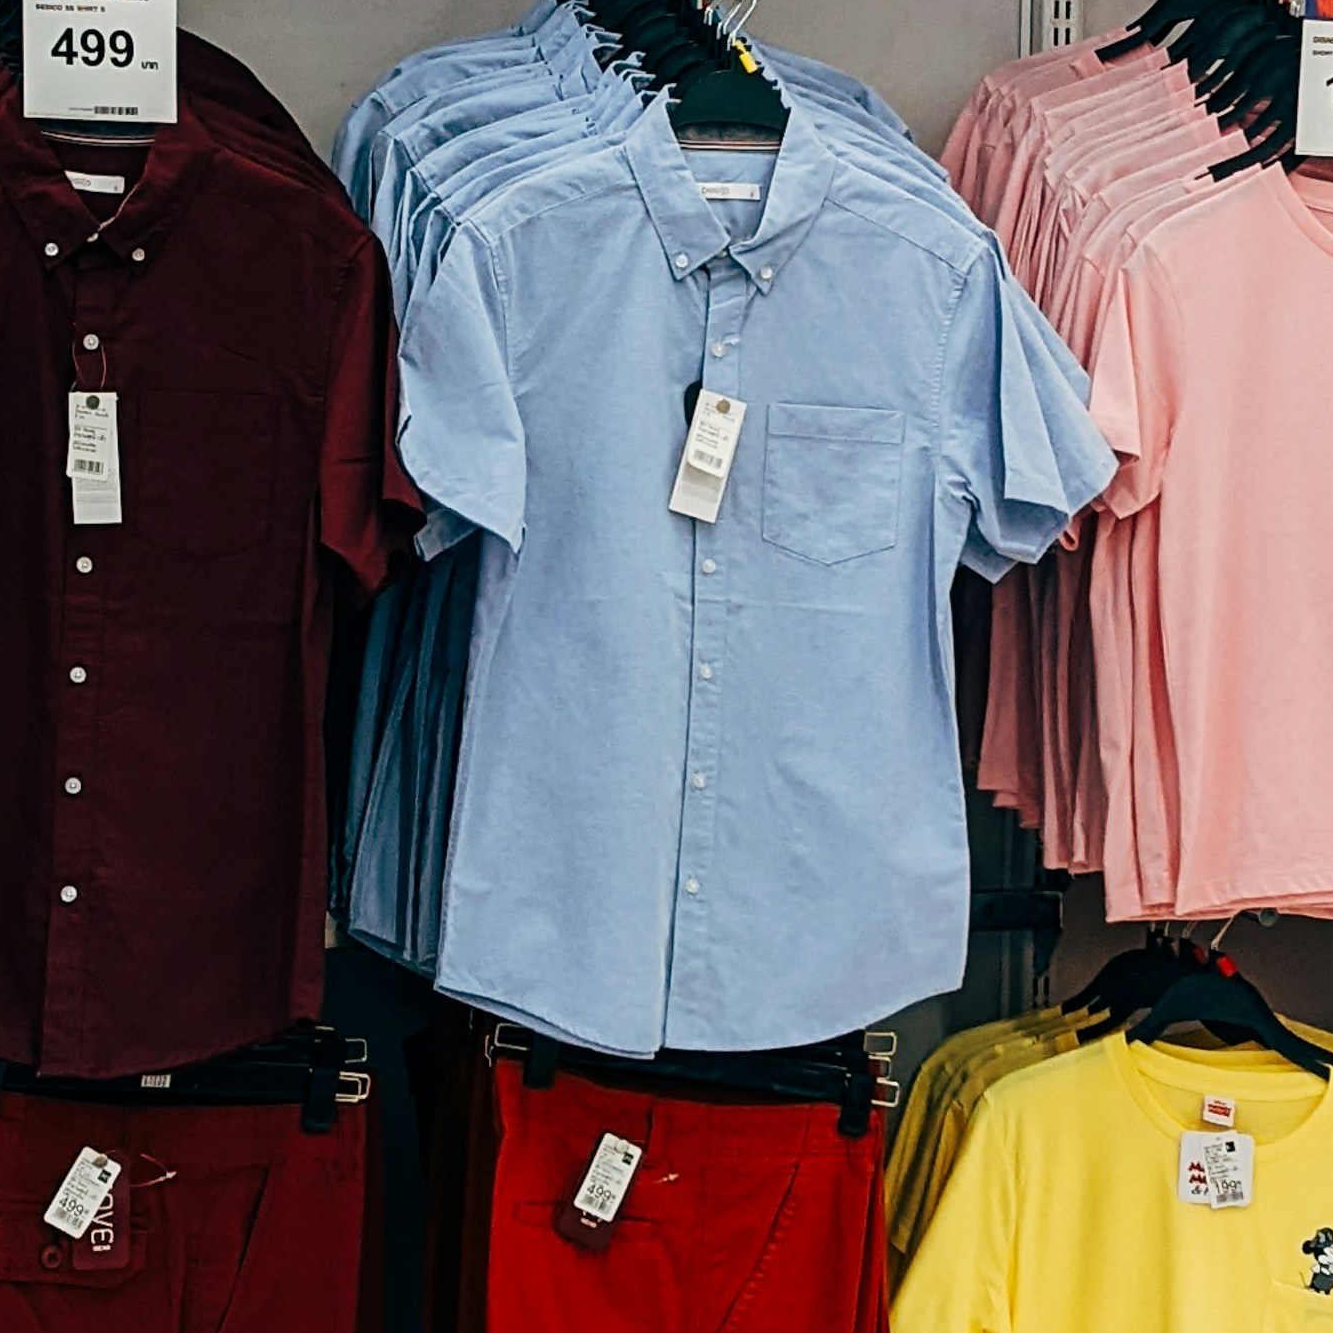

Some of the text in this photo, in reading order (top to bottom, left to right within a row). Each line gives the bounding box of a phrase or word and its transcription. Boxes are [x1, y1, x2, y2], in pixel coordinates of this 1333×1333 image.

[51, 27, 135, 68] 499
[587, 1184, 612, 1200] 499
[59, 1197, 83, 1216] 499
